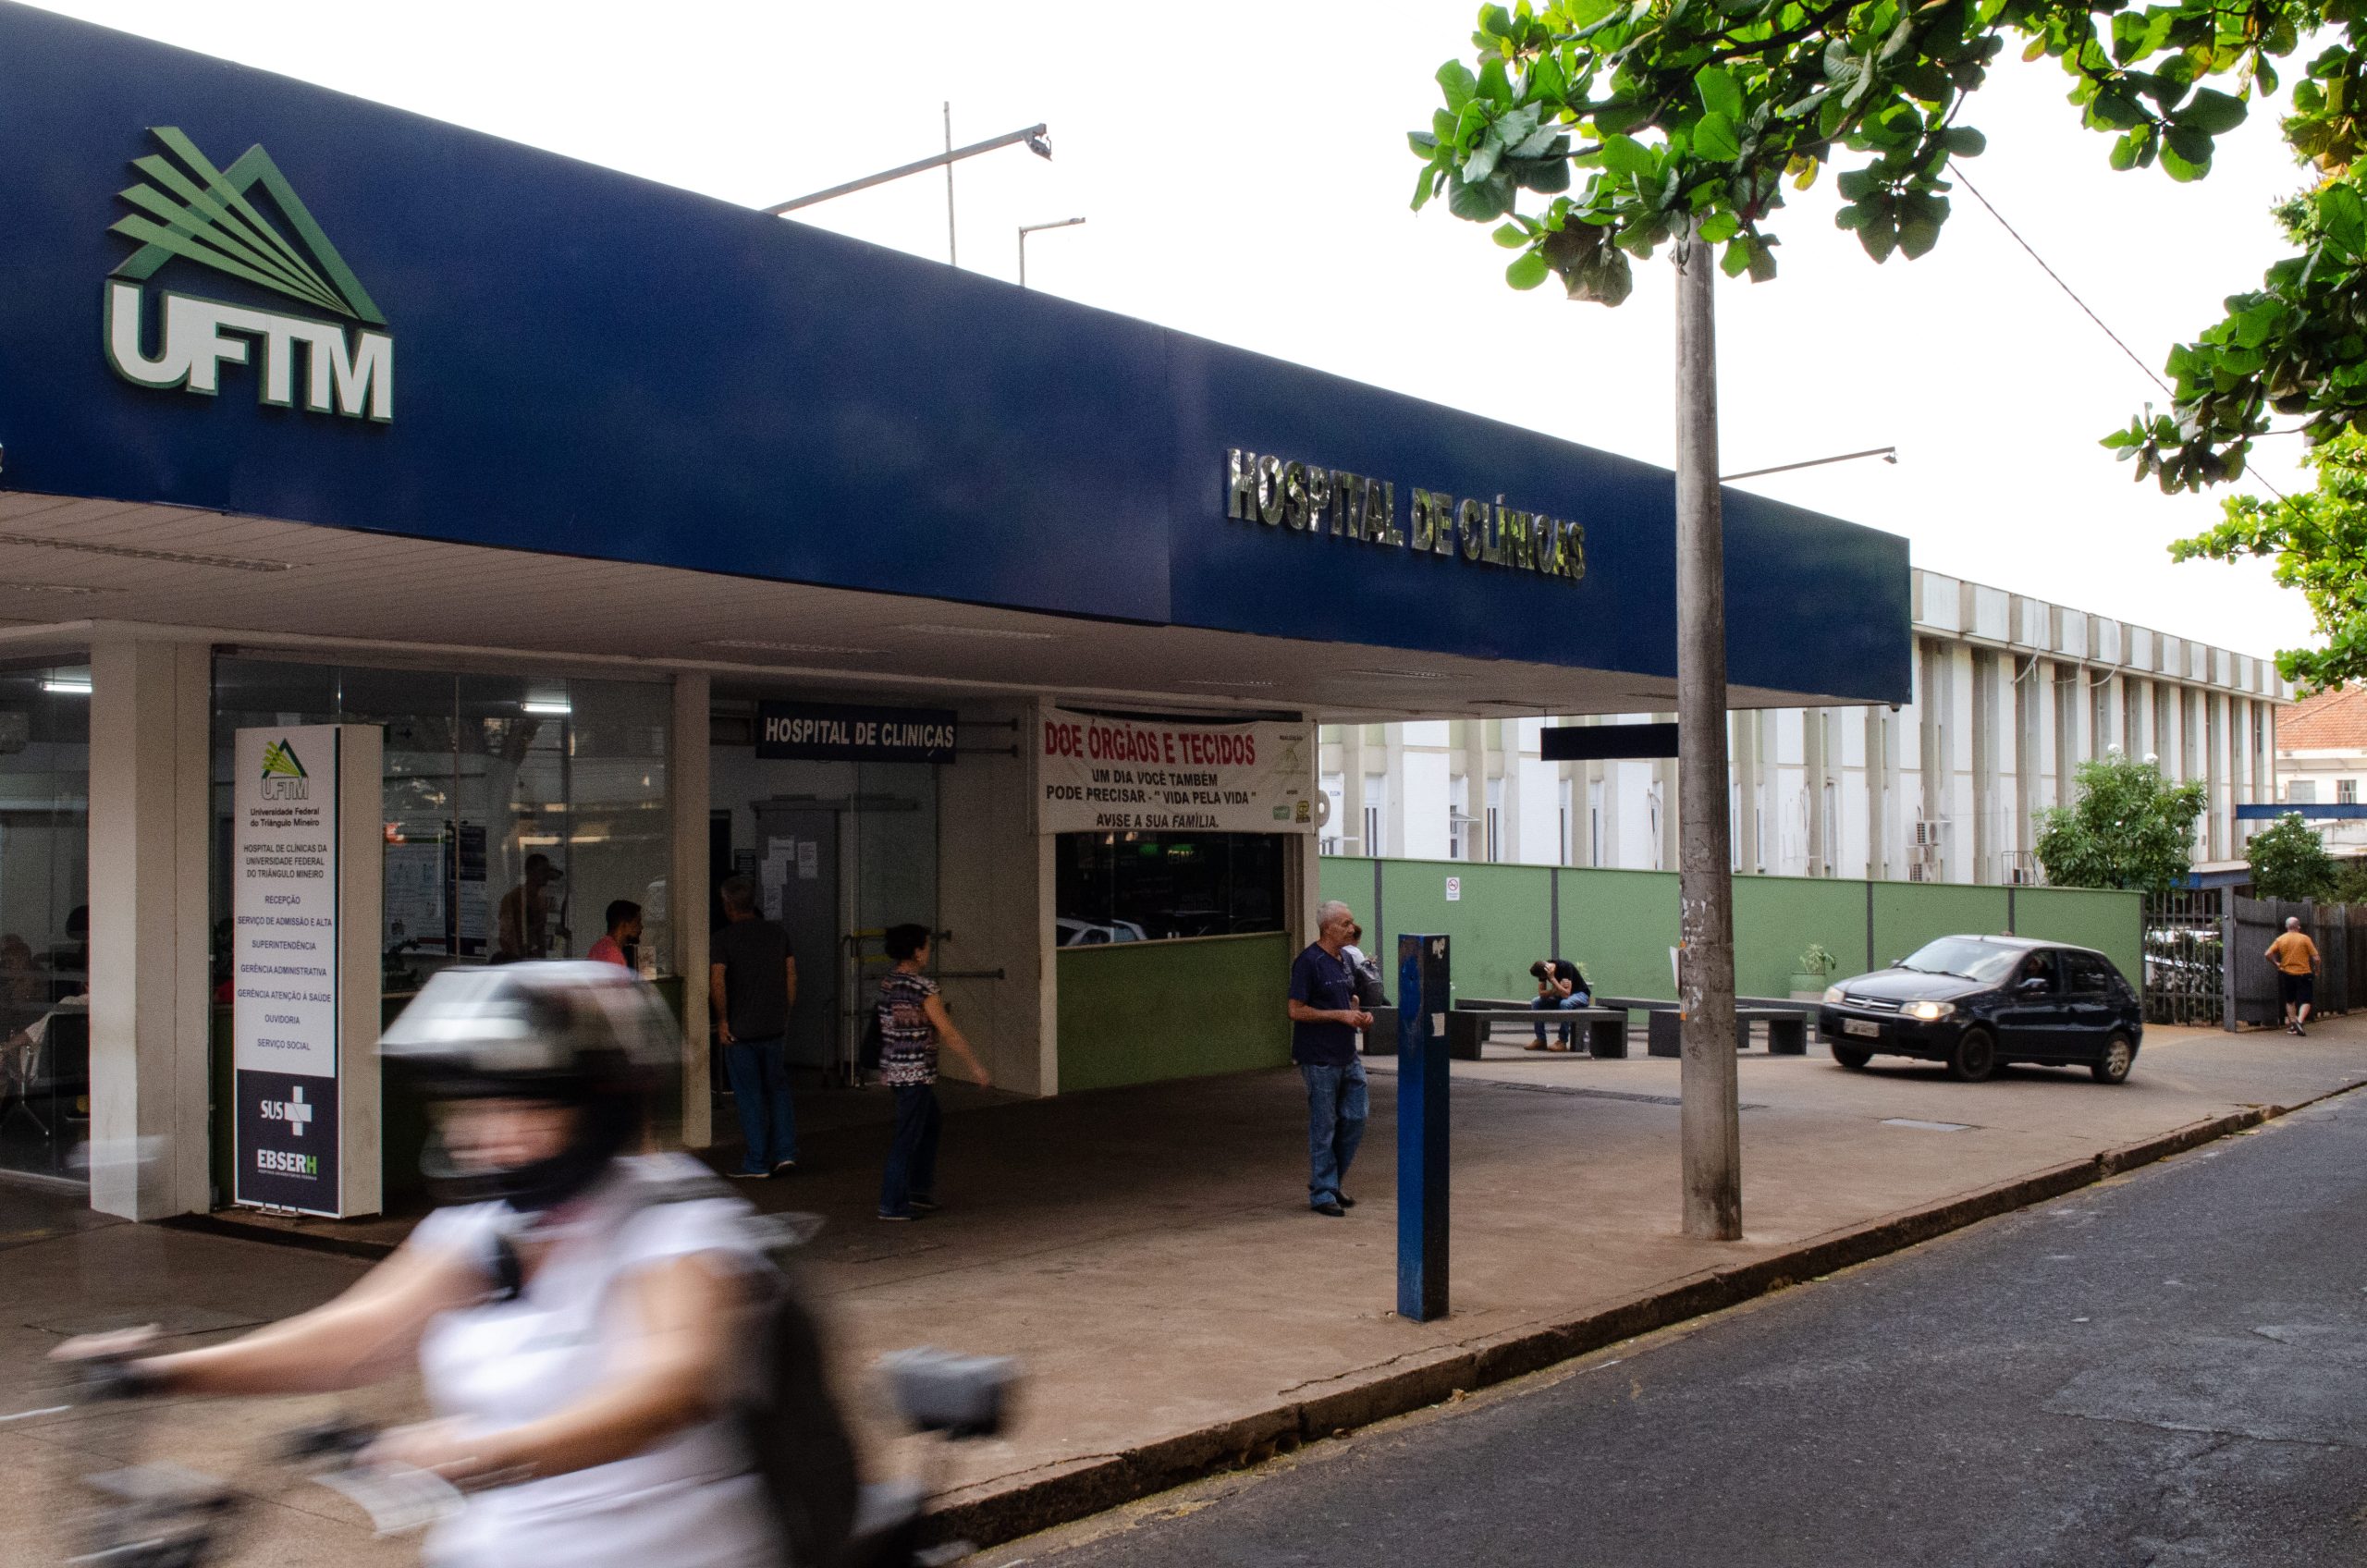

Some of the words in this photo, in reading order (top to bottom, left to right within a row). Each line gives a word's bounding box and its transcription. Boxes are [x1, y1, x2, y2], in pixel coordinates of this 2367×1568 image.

[104, 278, 393, 424] UFTM
[1227, 448, 1404, 546] HOSPITAL
[1411, 487, 1454, 556] DE
[1457, 494, 1587, 580] CLÍNICAS
[765, 717, 850, 744] HOSPITAL
[854, 722, 877, 745] DE
[1044, 720, 1084, 758] DOE
[1087, 718, 1160, 764] ÓRGÃOS
[1162, 731, 1176, 765] E
[1178, 731, 1257, 766] TECIDOS
[1091, 768, 1110, 784] UM
[1113, 770, 1134, 784] DIA
[1136, 769, 1167, 786] VOCÊ
[1168, 771, 1219, 787] TAMBÉM
[261, 776, 310, 801] UFTM
[1046, 785, 1083, 801] PODE
[1085, 787, 1147, 803] PRECISAR
[1162, 790, 1191, 804] VIDA
[1193, 791, 1221, 804] PELA
[1223, 792, 1249, 804] VIDA
[250, 807, 293, 815] Universidade
[294, 807, 320, 815] Federal
[250, 818, 259, 827] do
[260, 818, 292, 828] Triângulo
[293, 818, 320, 827] Mineiro
[1096, 813, 1131, 827] AVISE
[1134, 814, 1143, 827] A
[1145, 814, 1170, 828] SUA
[243, 844, 275, 852] HOSPITAL
[276, 844, 285, 852] DE
[286, 842, 317, 853] CLÍNICAS
[317, 844, 328, 852] DA
[246, 856, 293, 865] UNIVERSIDADE
[294, 857, 325, 866] FEDERAL
[246, 869, 257, 878] DO
[258, 867, 295, 878] TRIÂNGULO
[296, 869, 325, 878] MINEIRO
[264, 894, 301, 906] RECEPÇÃO
[238, 915, 265, 926] SERVIÇO
[265, 916, 276, 925] DE
[276, 916, 310, 926] ADMISSÃO
[310, 918, 315, 926] E
[315, 918, 333, 927] ALTA
[251, 939, 317, 950] SUPERINTENDÊNCIA
[240, 963, 273, 974] GERÊNCIA
[273, 965, 327, 977] ADMINISTRATIVA
[238, 988, 270, 998] GERÊNCIA
[270, 990, 301, 1002] ATENÇÃO
[264, 1013, 300, 1024] OUVIDORIA
[257, 1038, 286, 1050] SERVIÇO
[287, 1040, 311, 1051] SOCIAL
[261, 1099, 284, 1120] SUS
[257, 1149, 317, 1175] EBSERH
